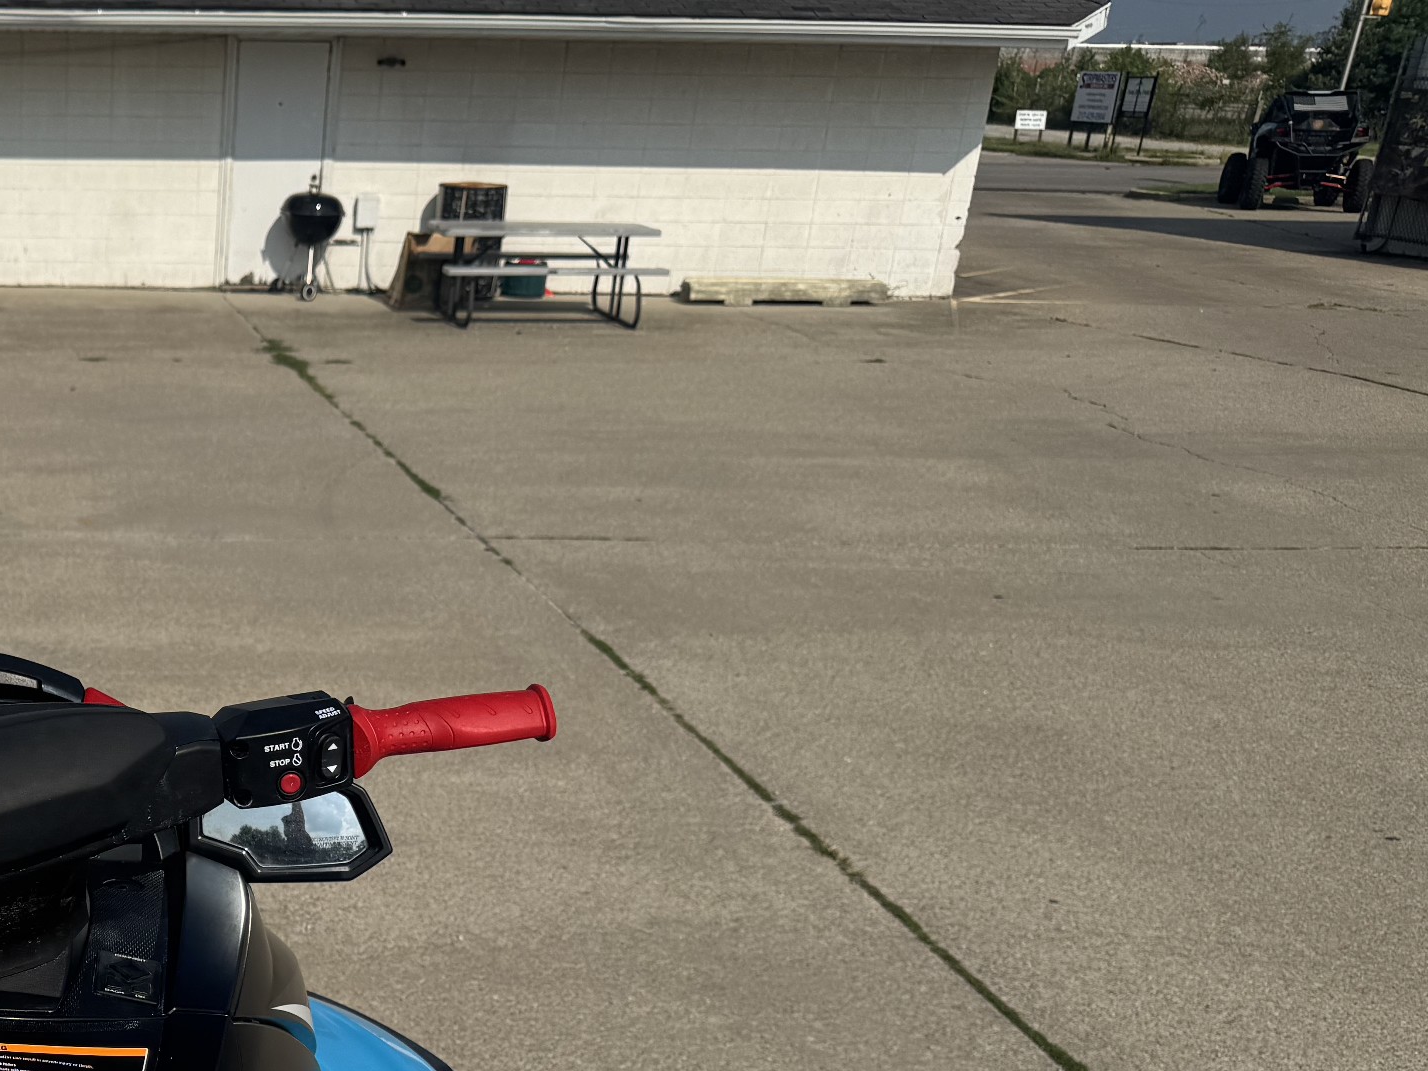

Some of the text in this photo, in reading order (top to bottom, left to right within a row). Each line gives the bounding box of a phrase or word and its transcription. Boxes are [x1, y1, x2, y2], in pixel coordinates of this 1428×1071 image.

[315, 707, 335, 715] SPEED
[319, 710, 341, 719] ADJUST
[264, 743, 290, 753] START
[270, 759, 290, 767] STOP
